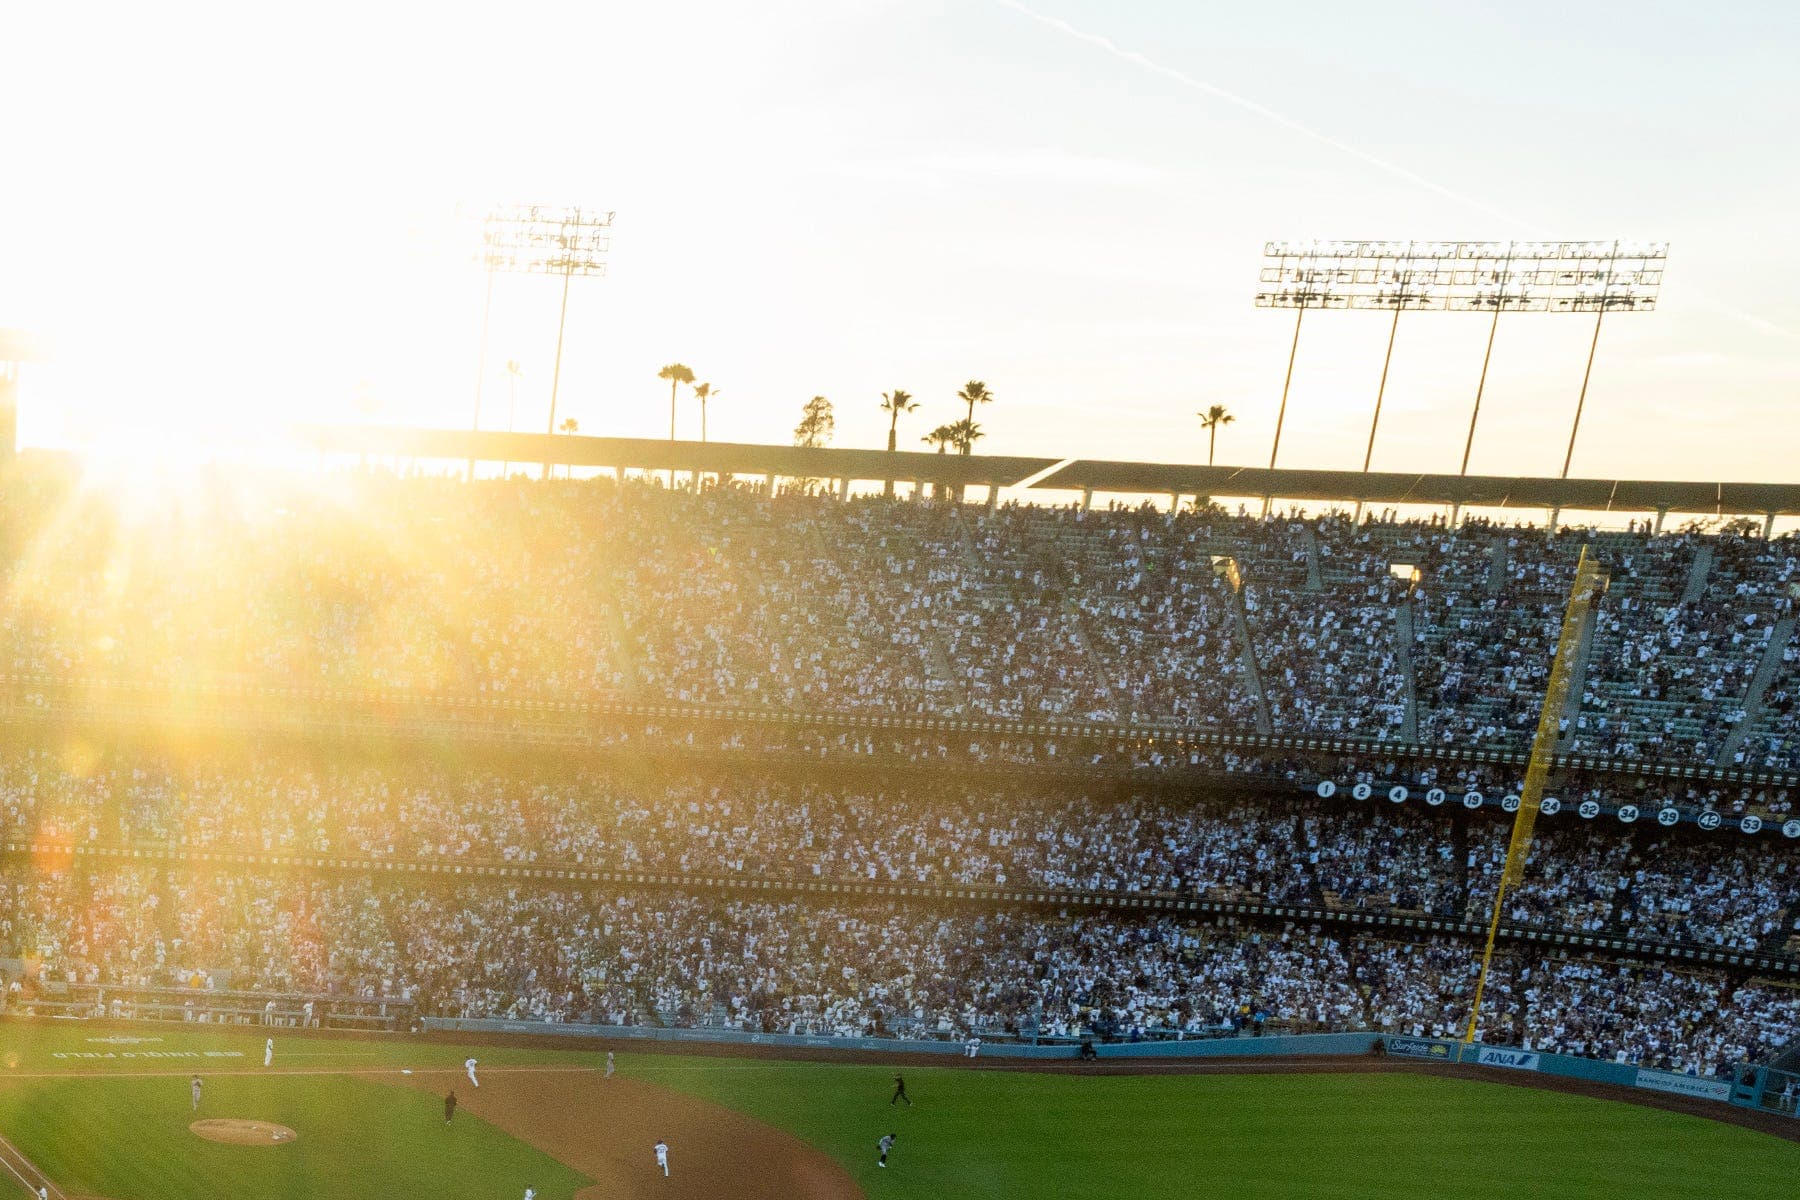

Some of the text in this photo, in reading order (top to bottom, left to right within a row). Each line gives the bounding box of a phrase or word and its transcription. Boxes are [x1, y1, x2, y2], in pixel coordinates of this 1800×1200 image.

[1430, 792, 1441, 801] 14
[1467, 795, 1479, 805] 19
[1504, 798, 1519, 808] 20
[1543, 801, 1558, 811] 24
[1581, 805, 1596, 815] 32
[1620, 808, 1636, 819] 34
[1661, 811, 1676, 822] 39
[1700, 815, 1718, 827] 42
[1743, 819, 1759, 830] 53
[1483, 1052, 1516, 1065] ANA
